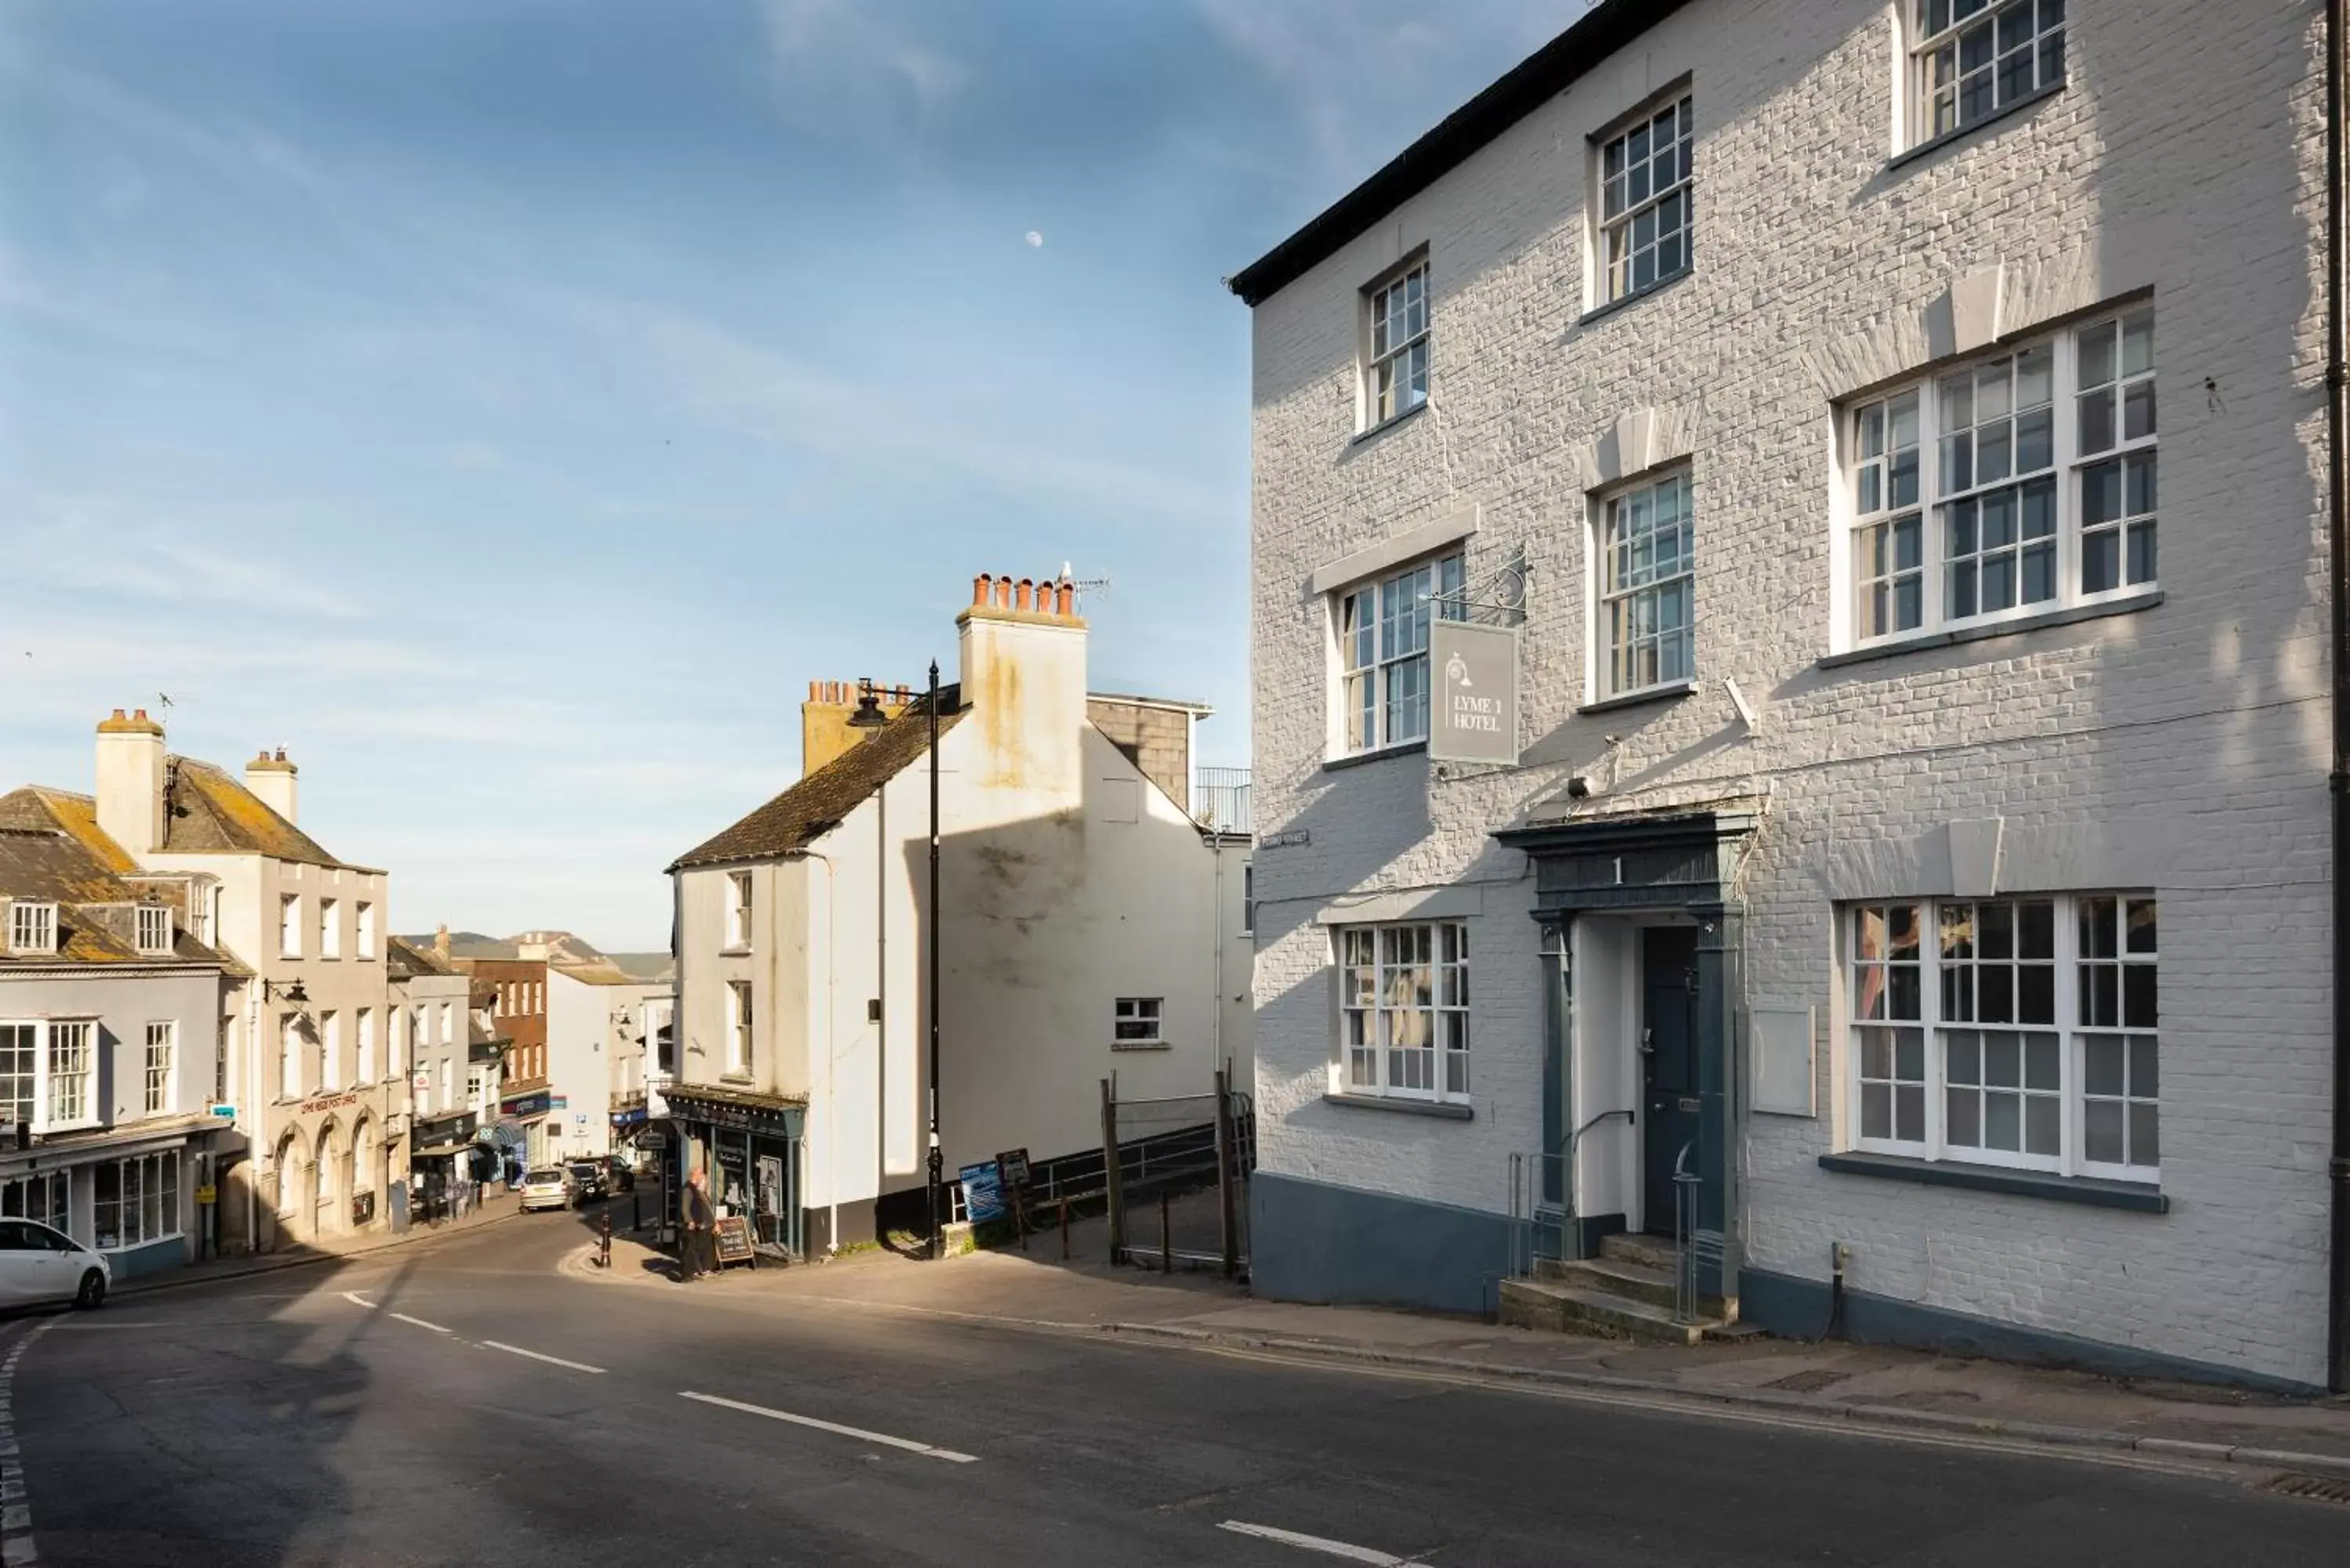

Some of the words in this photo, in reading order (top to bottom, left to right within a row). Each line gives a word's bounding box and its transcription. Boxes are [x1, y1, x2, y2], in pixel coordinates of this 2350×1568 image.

[1455, 695, 1491, 713] LYME
[1495, 699, 1502, 714] 1
[1455, 713, 1501, 732] HOTEL
[1612, 856, 1625, 885] 1
